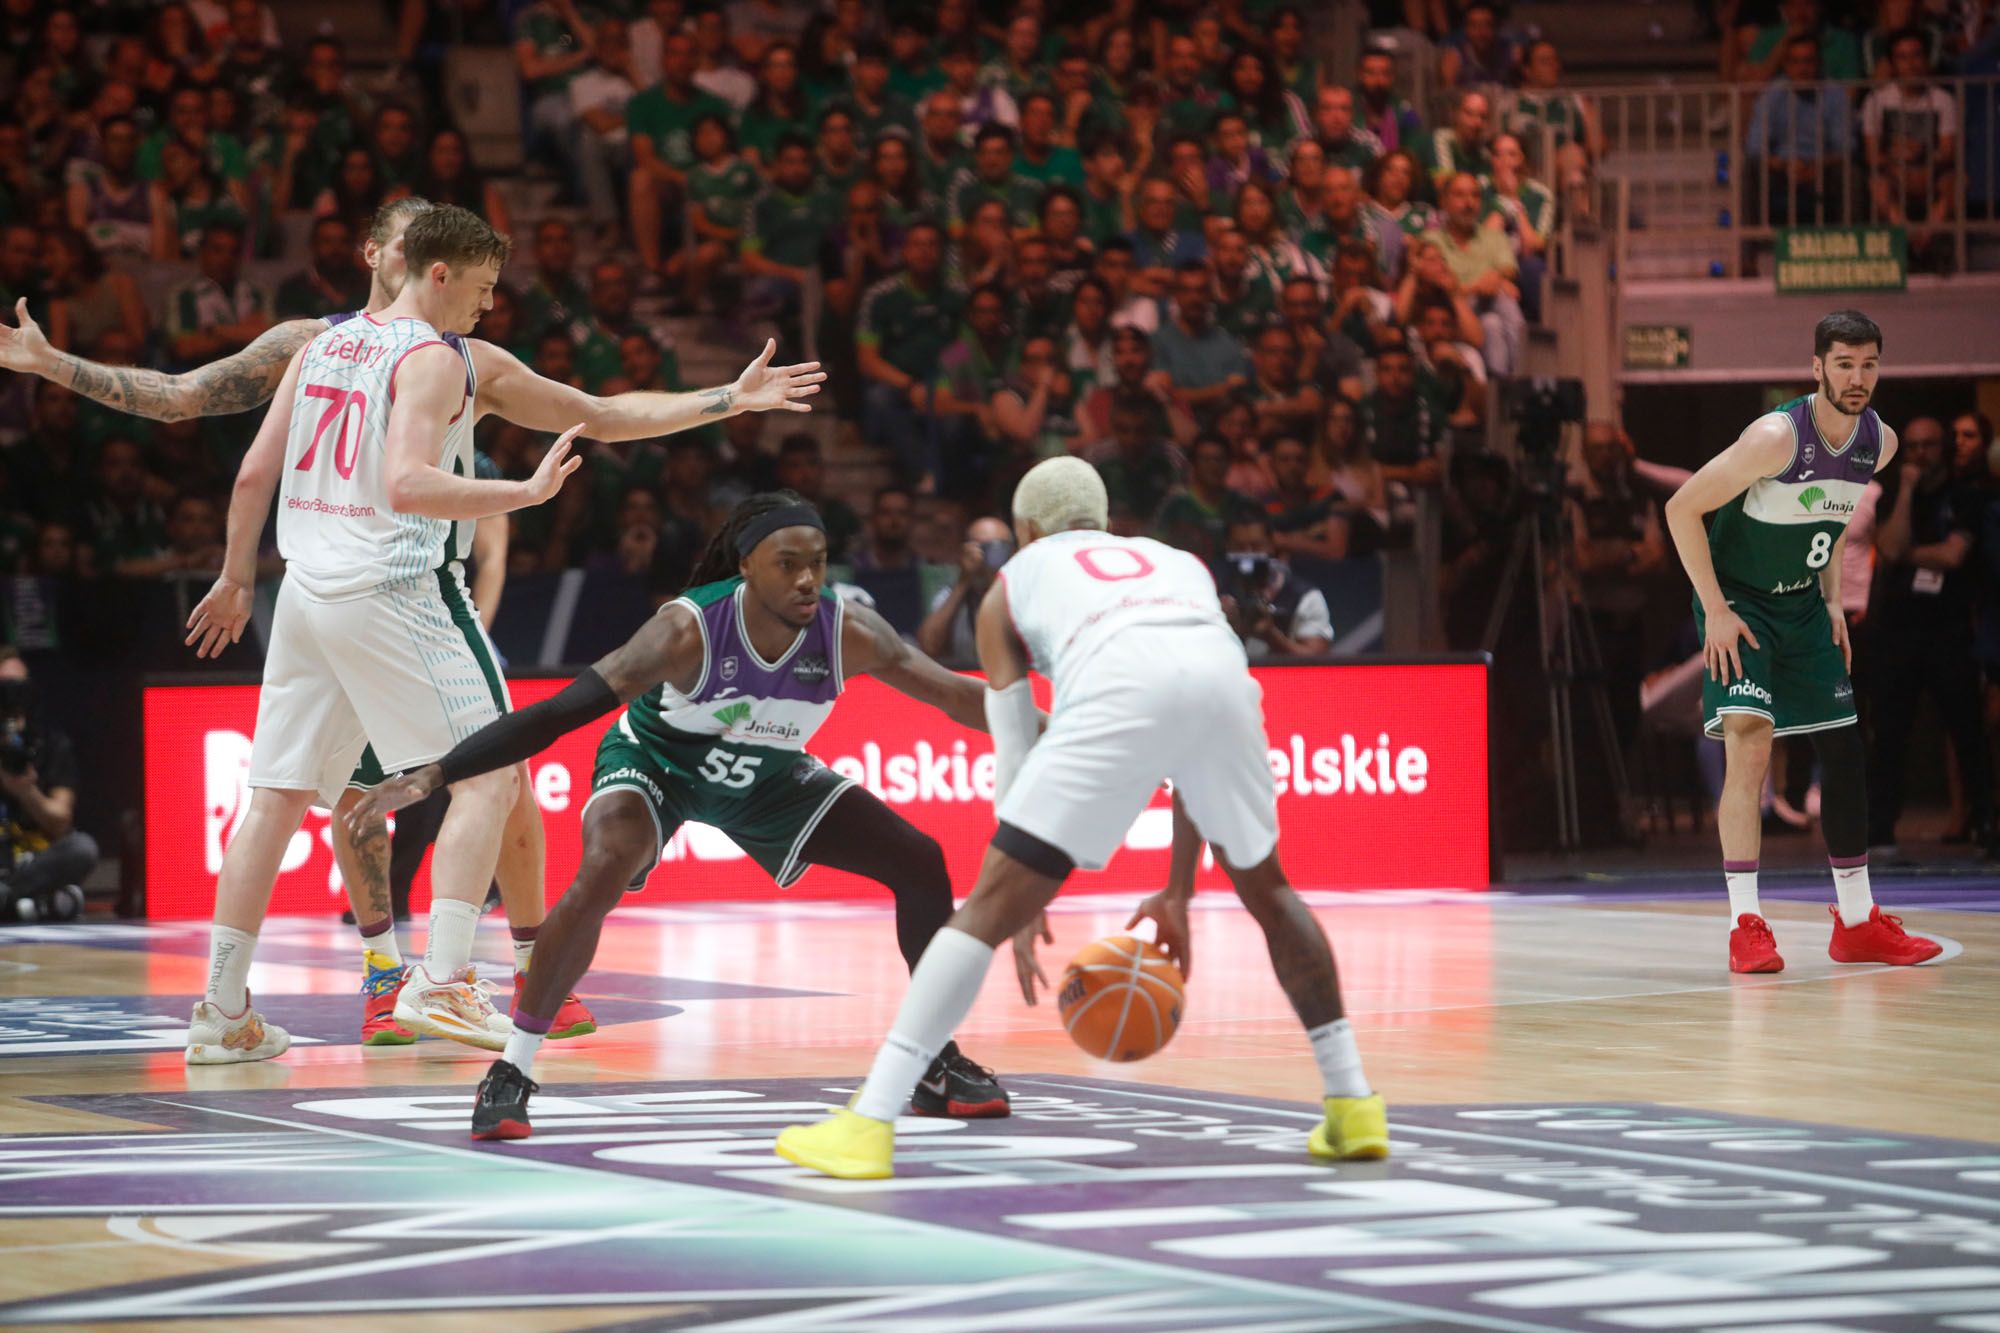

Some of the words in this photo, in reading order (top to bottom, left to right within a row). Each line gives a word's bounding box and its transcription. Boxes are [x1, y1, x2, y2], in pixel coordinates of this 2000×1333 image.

[295, 383, 367, 480] 70
[1073, 547, 1155, 581] 0
[1806, 531, 1832, 569] 8
[697, 747, 763, 789] 55
[208, 942, 236, 995] SPALDING
